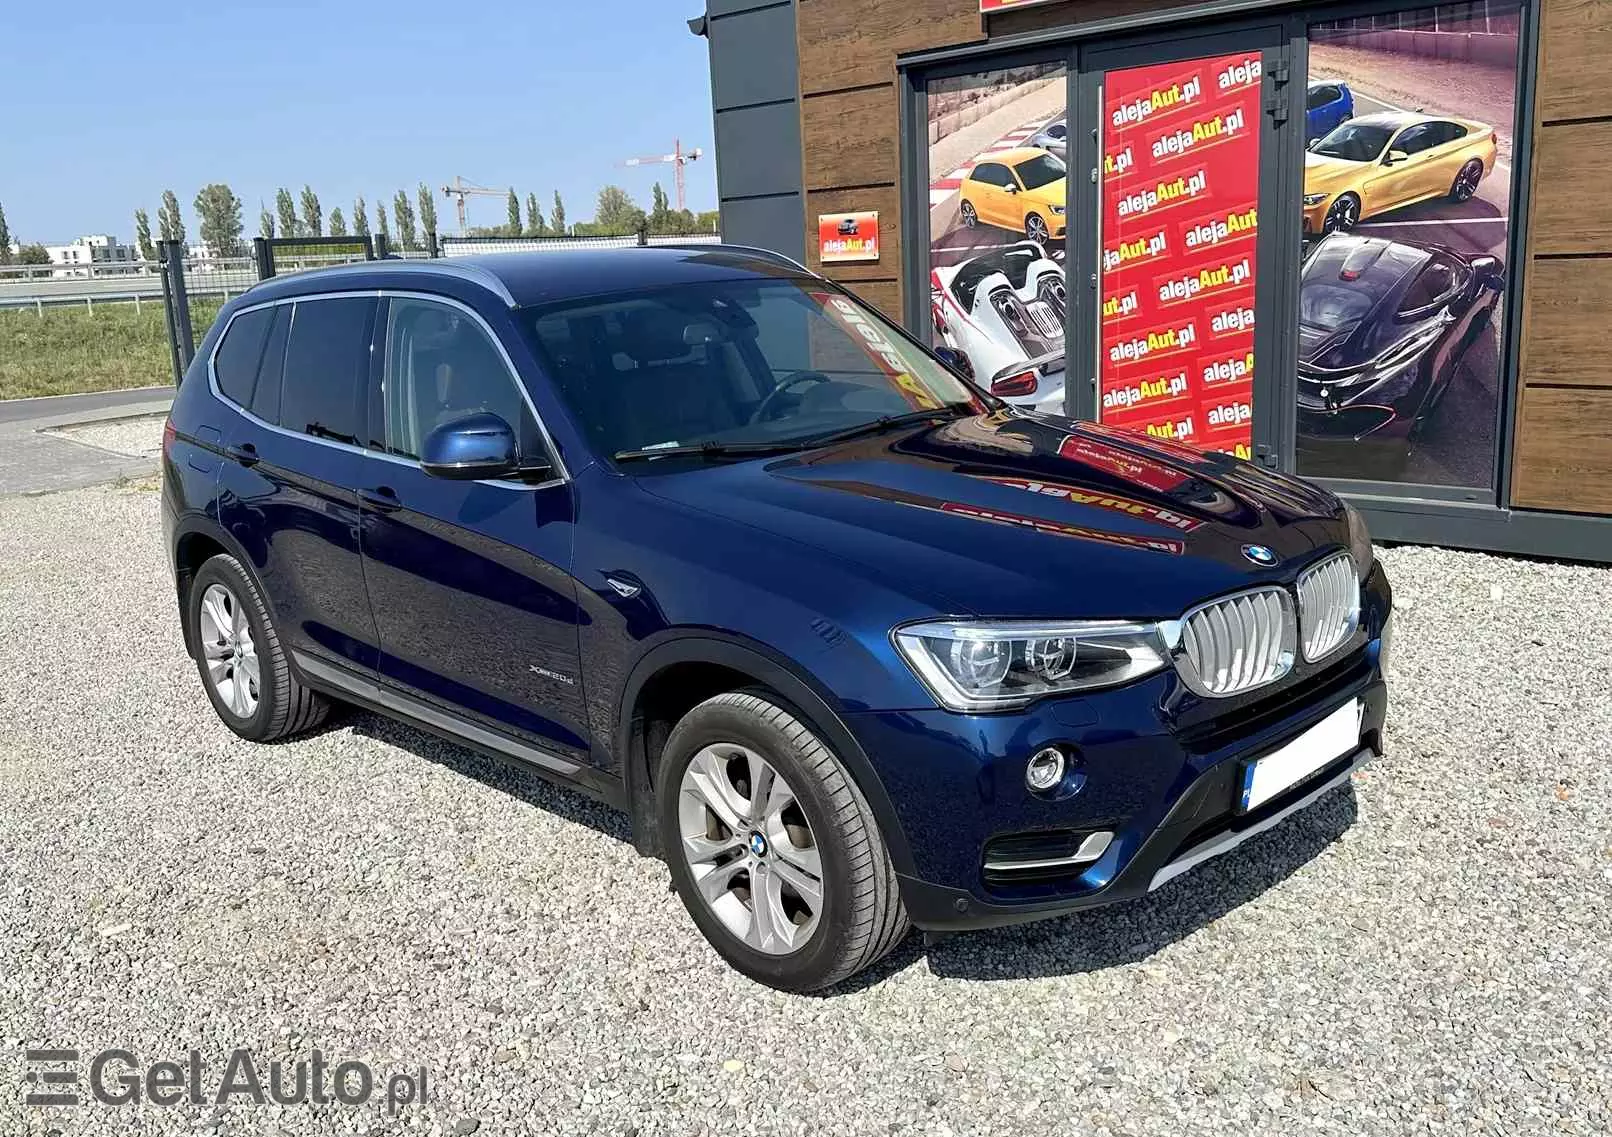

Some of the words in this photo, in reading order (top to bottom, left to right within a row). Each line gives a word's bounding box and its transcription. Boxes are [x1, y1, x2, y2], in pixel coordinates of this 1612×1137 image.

[1218, 59, 1262, 89] aleja
[1112, 75, 1201, 127] alejaAut.pl
[1151, 108, 1244, 158] alejaAut.pl
[1117, 169, 1207, 217] alejaAut.pl
[823, 236, 875, 253] alejaAut.pl
[1185, 208, 1258, 247] alejaAut
[1159, 259, 1250, 301] alejaAut.pl
[1211, 307, 1255, 332] aleja
[1110, 323, 1195, 362] alejaAut.pl
[1103, 372, 1187, 407] alejaAut.pl
[1143, 416, 1193, 441] Aut.pl
